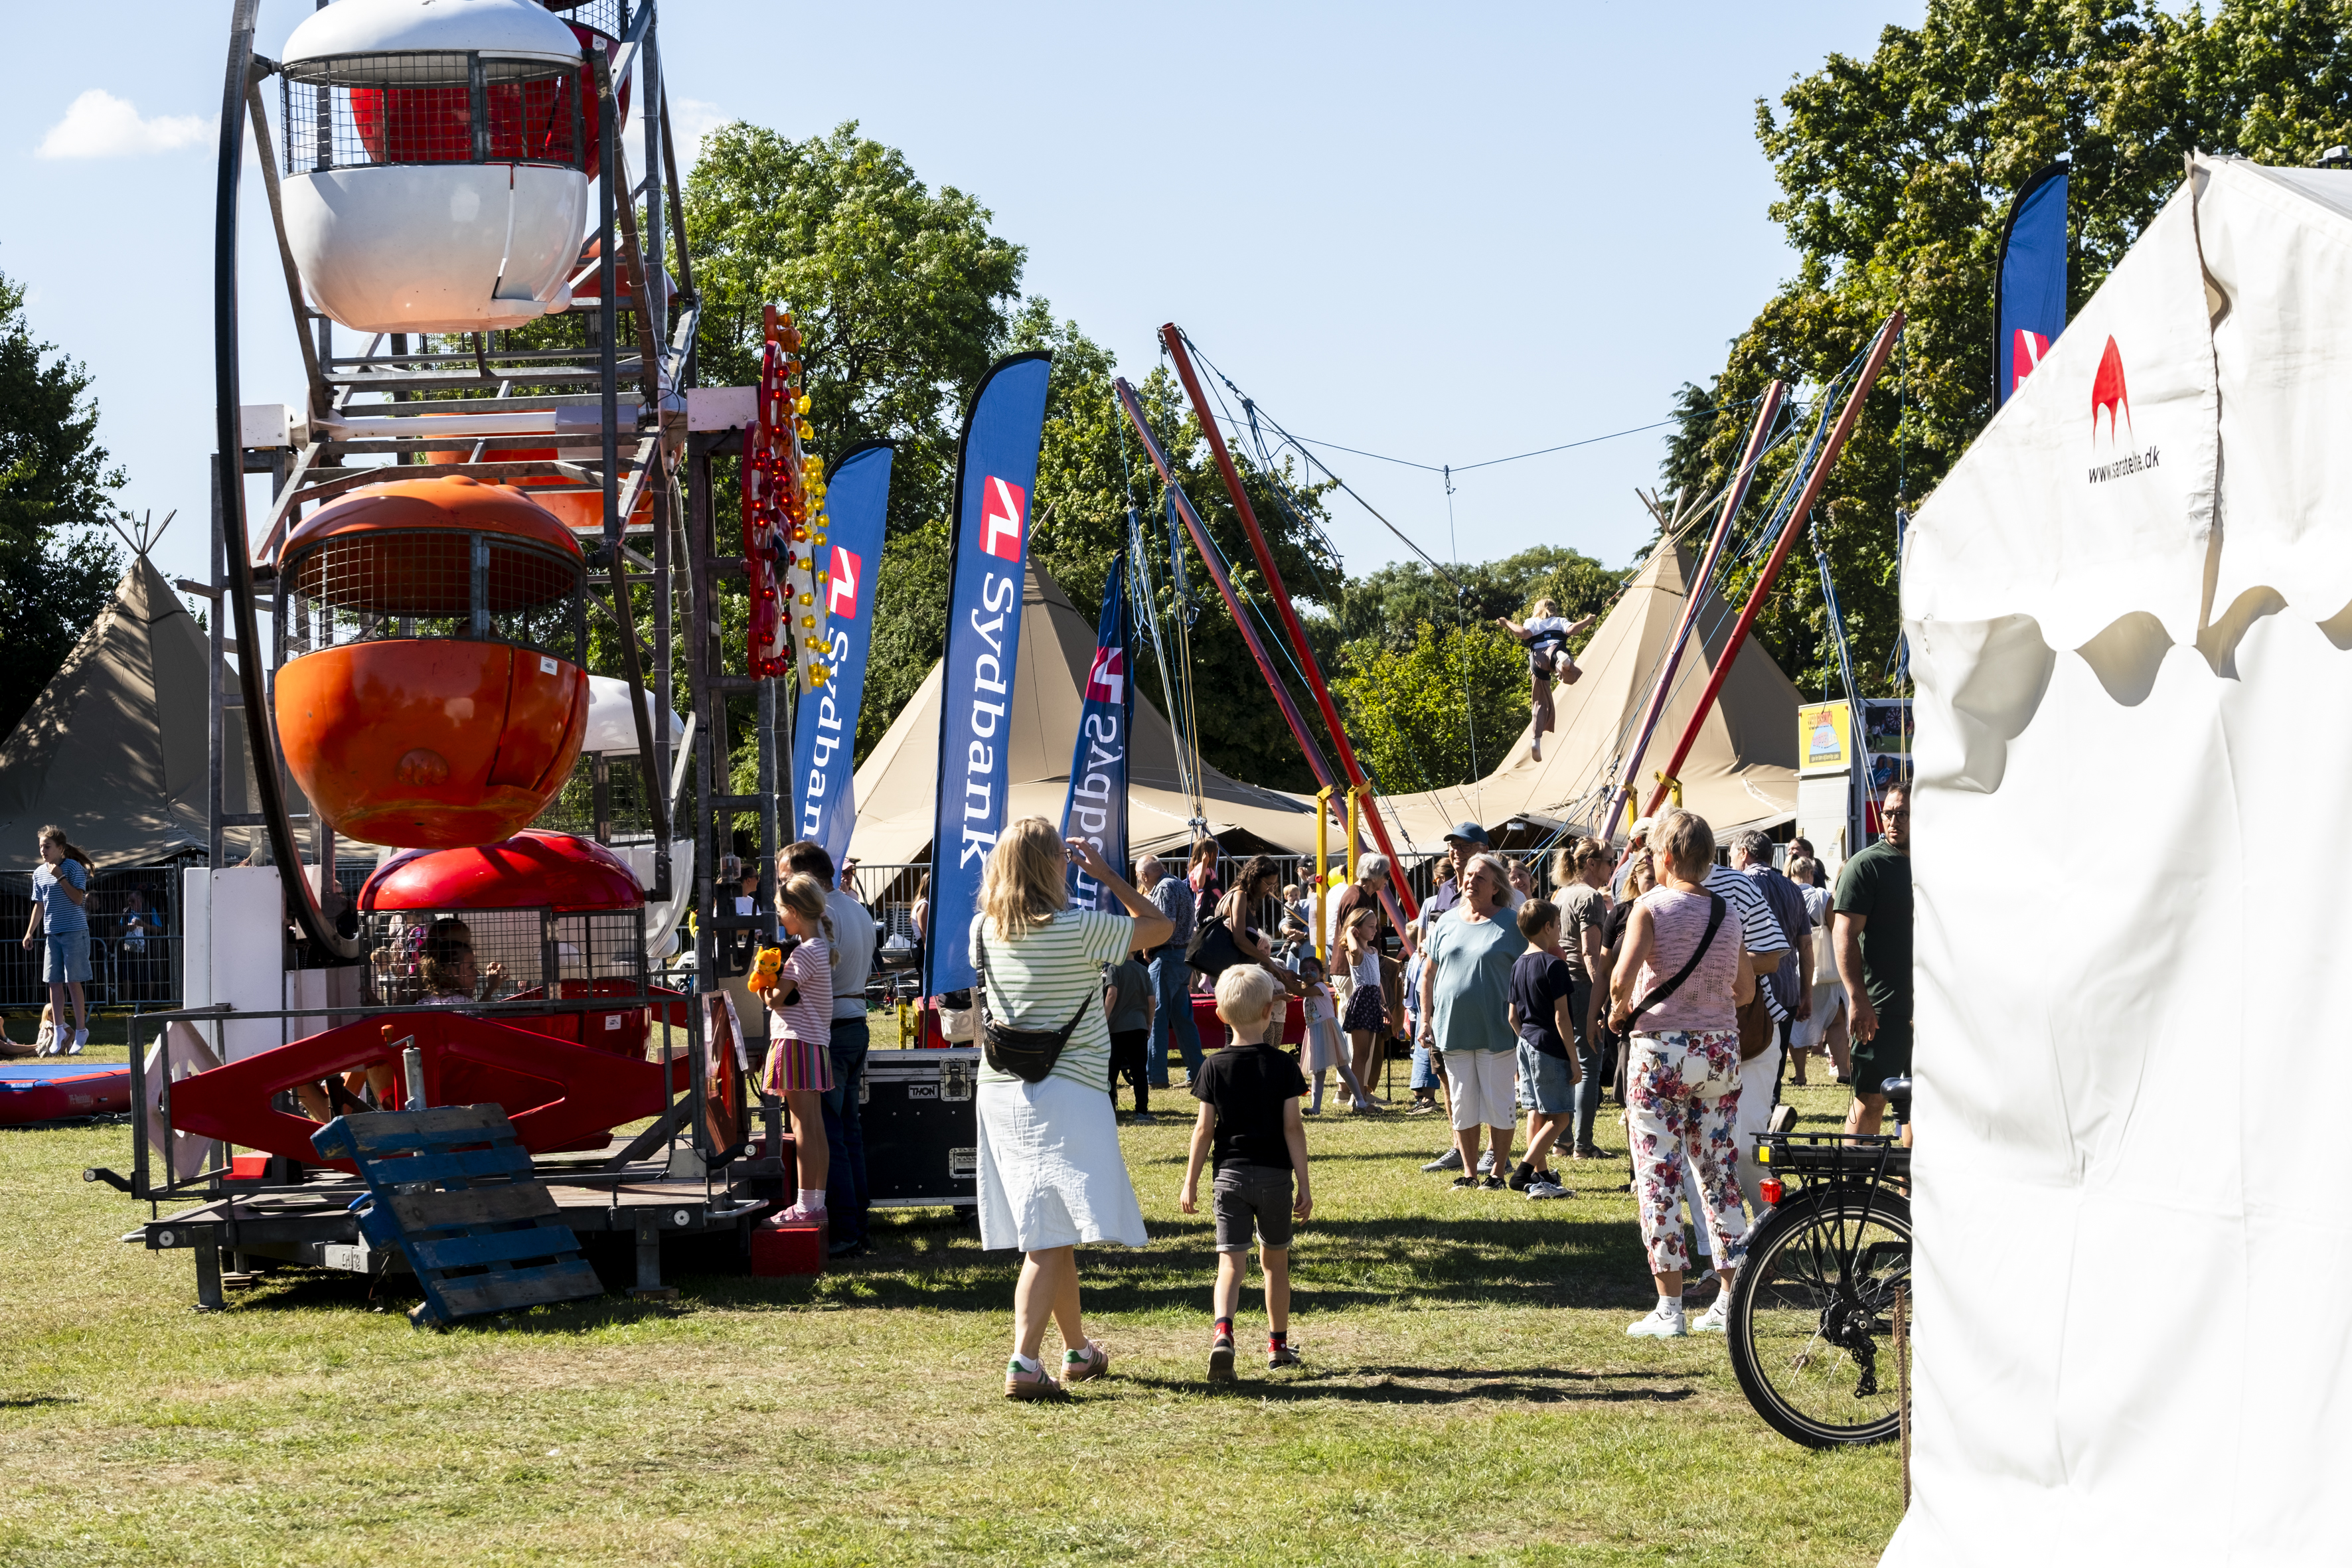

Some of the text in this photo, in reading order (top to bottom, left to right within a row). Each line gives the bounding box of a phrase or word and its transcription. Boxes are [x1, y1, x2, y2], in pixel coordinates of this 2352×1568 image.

[2088, 445, 2160, 483] www.saratelte.dk
[802, 627, 849, 848] Sydban
[959, 572, 1014, 870] Sydbank
[910, 1085, 937, 1096] THON
